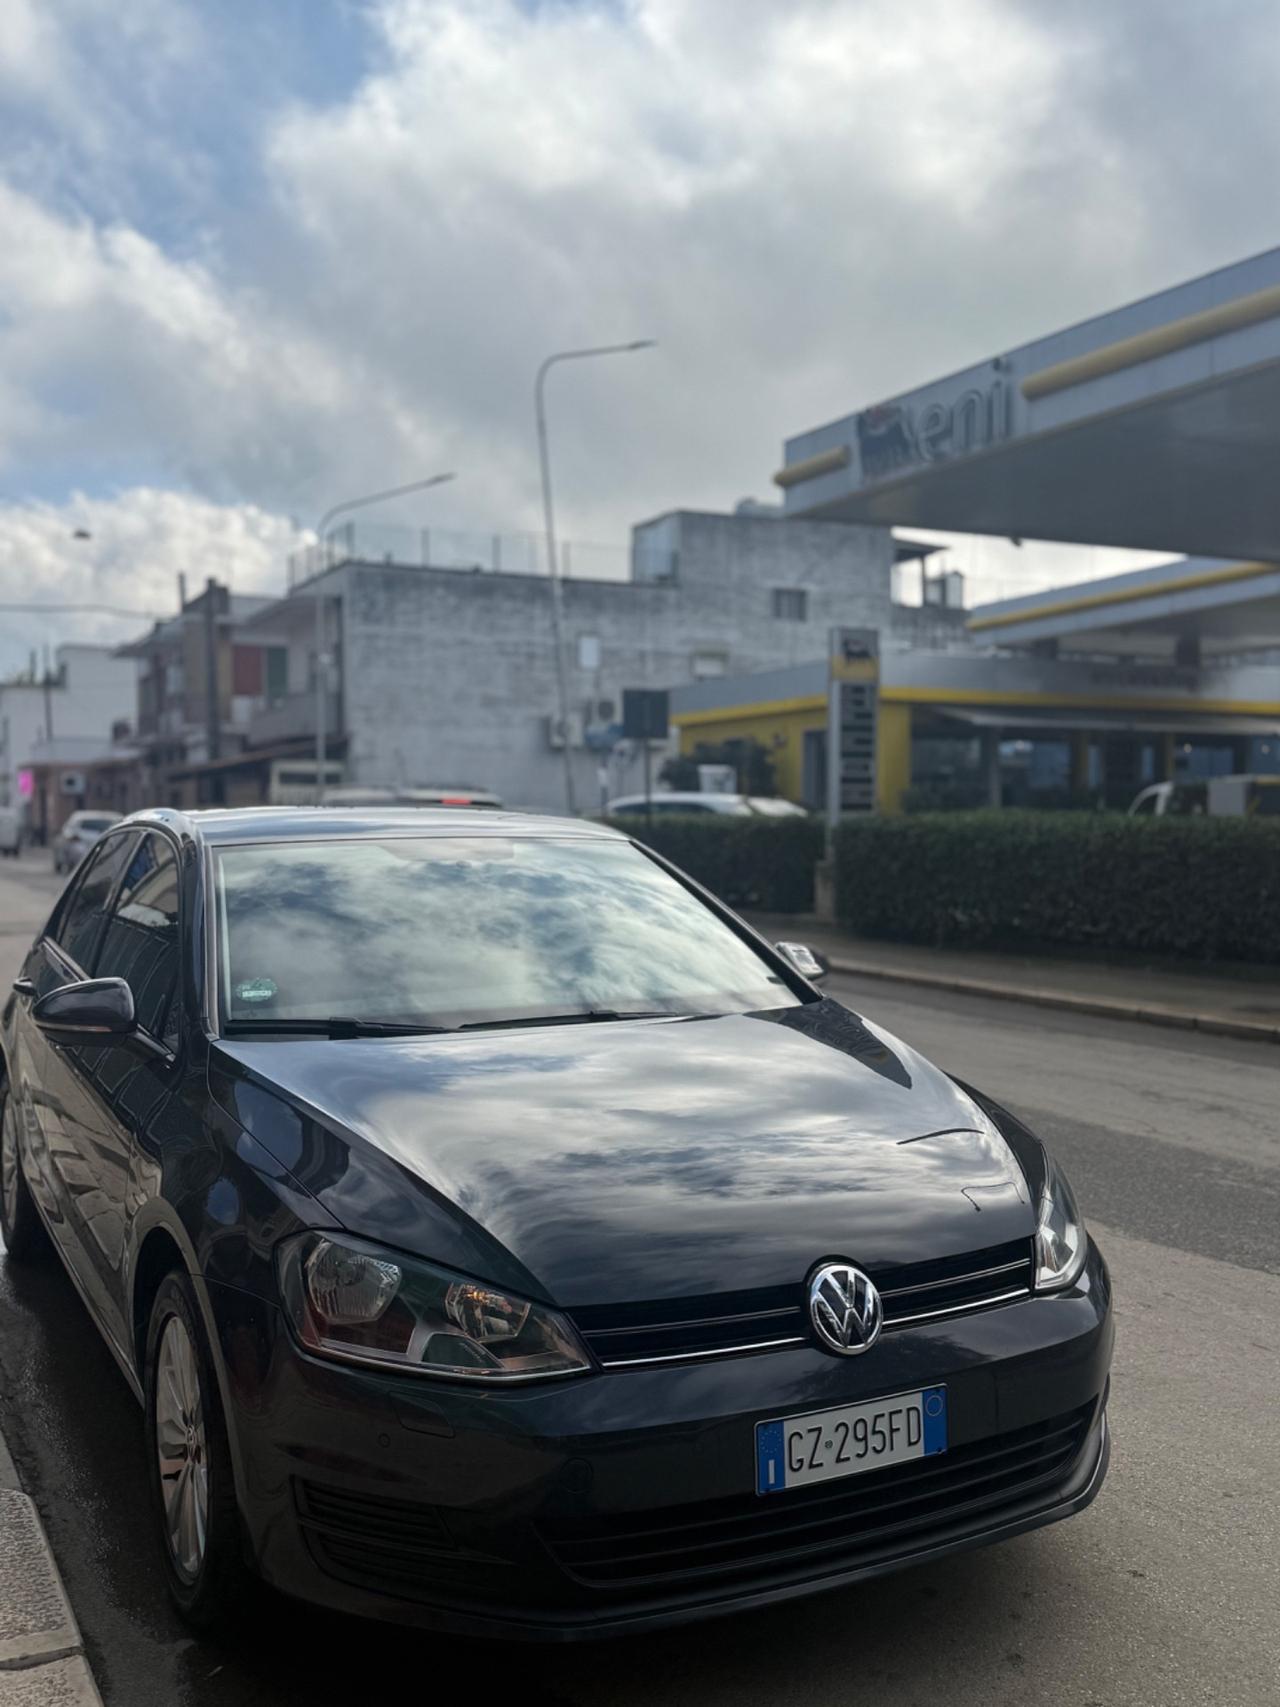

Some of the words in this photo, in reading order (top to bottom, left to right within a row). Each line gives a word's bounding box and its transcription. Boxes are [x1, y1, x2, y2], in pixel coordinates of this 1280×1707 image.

[918, 358, 1012, 461] eni
[788, 1427, 823, 1472] GZ
[834, 1406, 921, 1463] 295FD
